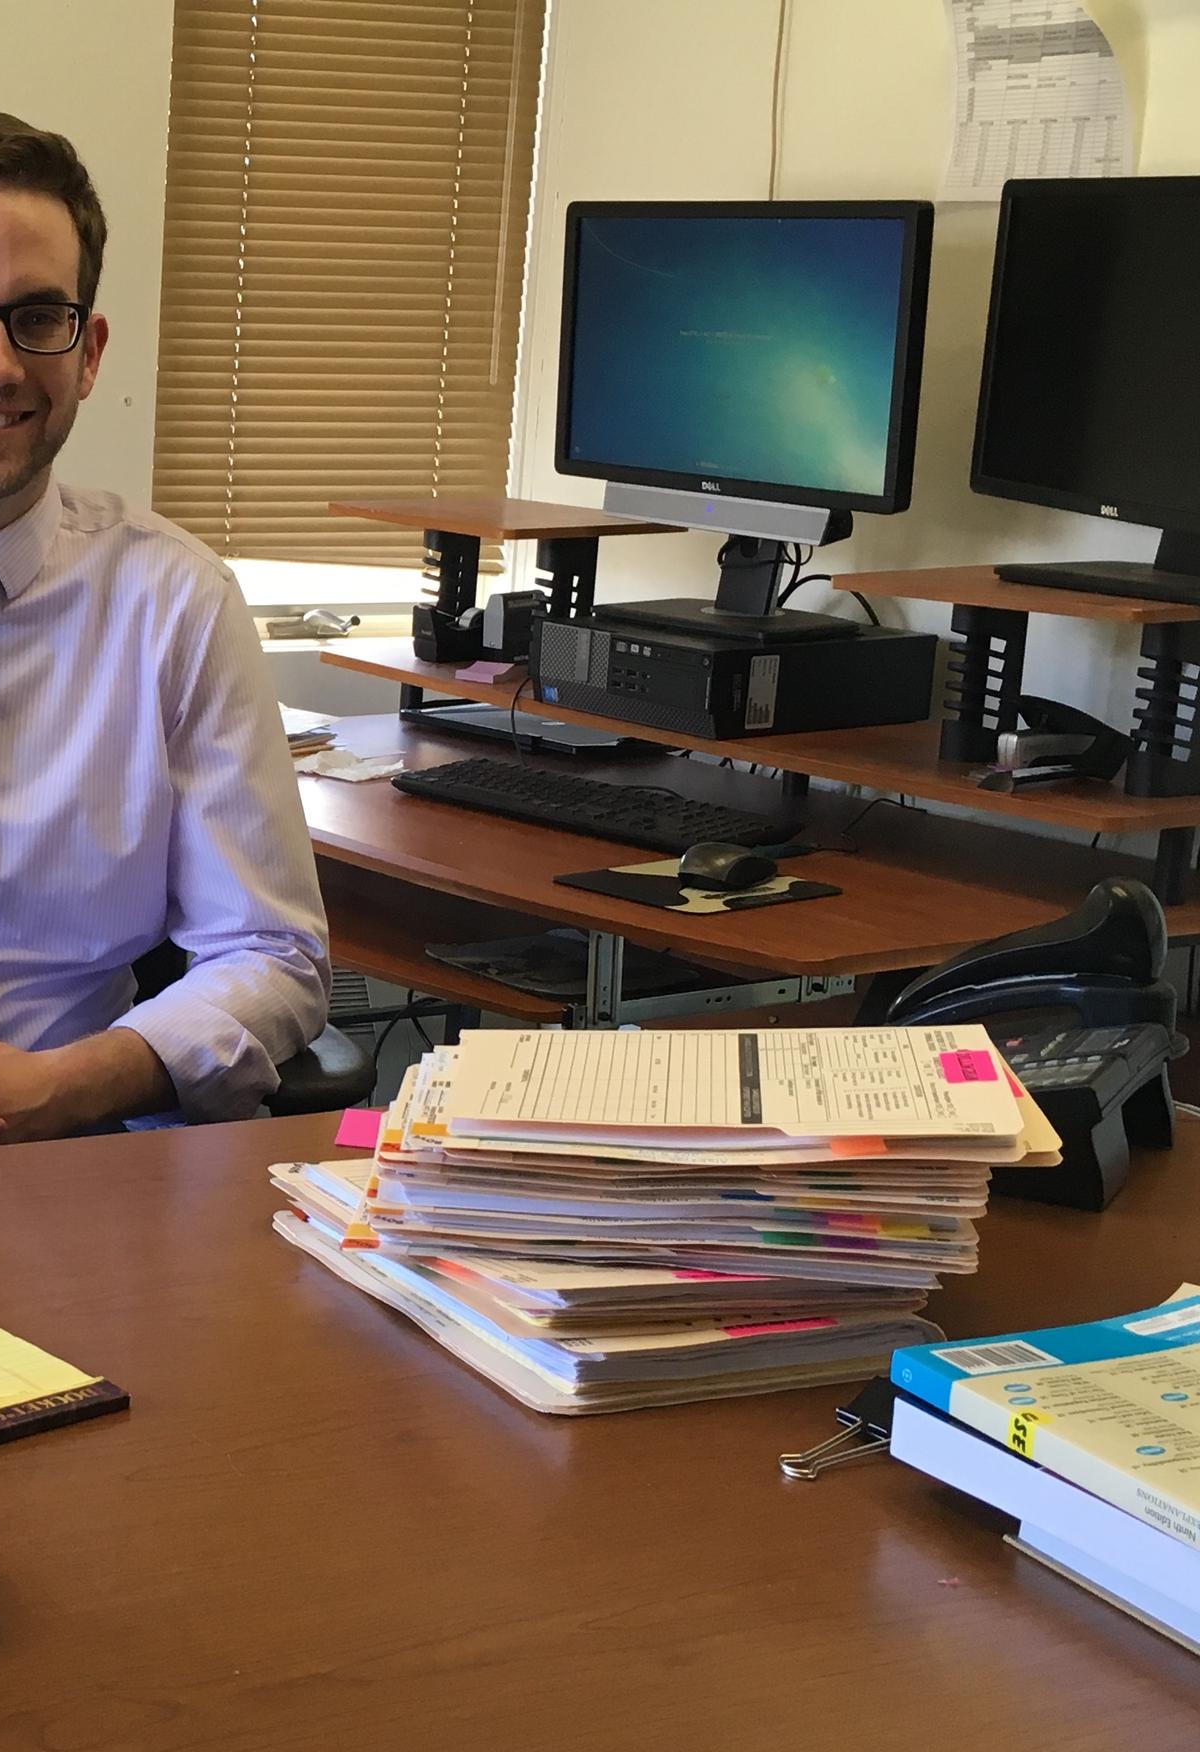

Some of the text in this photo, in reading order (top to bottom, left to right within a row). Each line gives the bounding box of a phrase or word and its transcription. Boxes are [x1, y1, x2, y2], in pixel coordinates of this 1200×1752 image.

[701, 481, 721, 492] DELL
[1100, 504, 1119, 517] DELL
[13, 1387, 97, 1416] DOCKET
[1144, 1505, 1197, 1543] Ninth Edition
